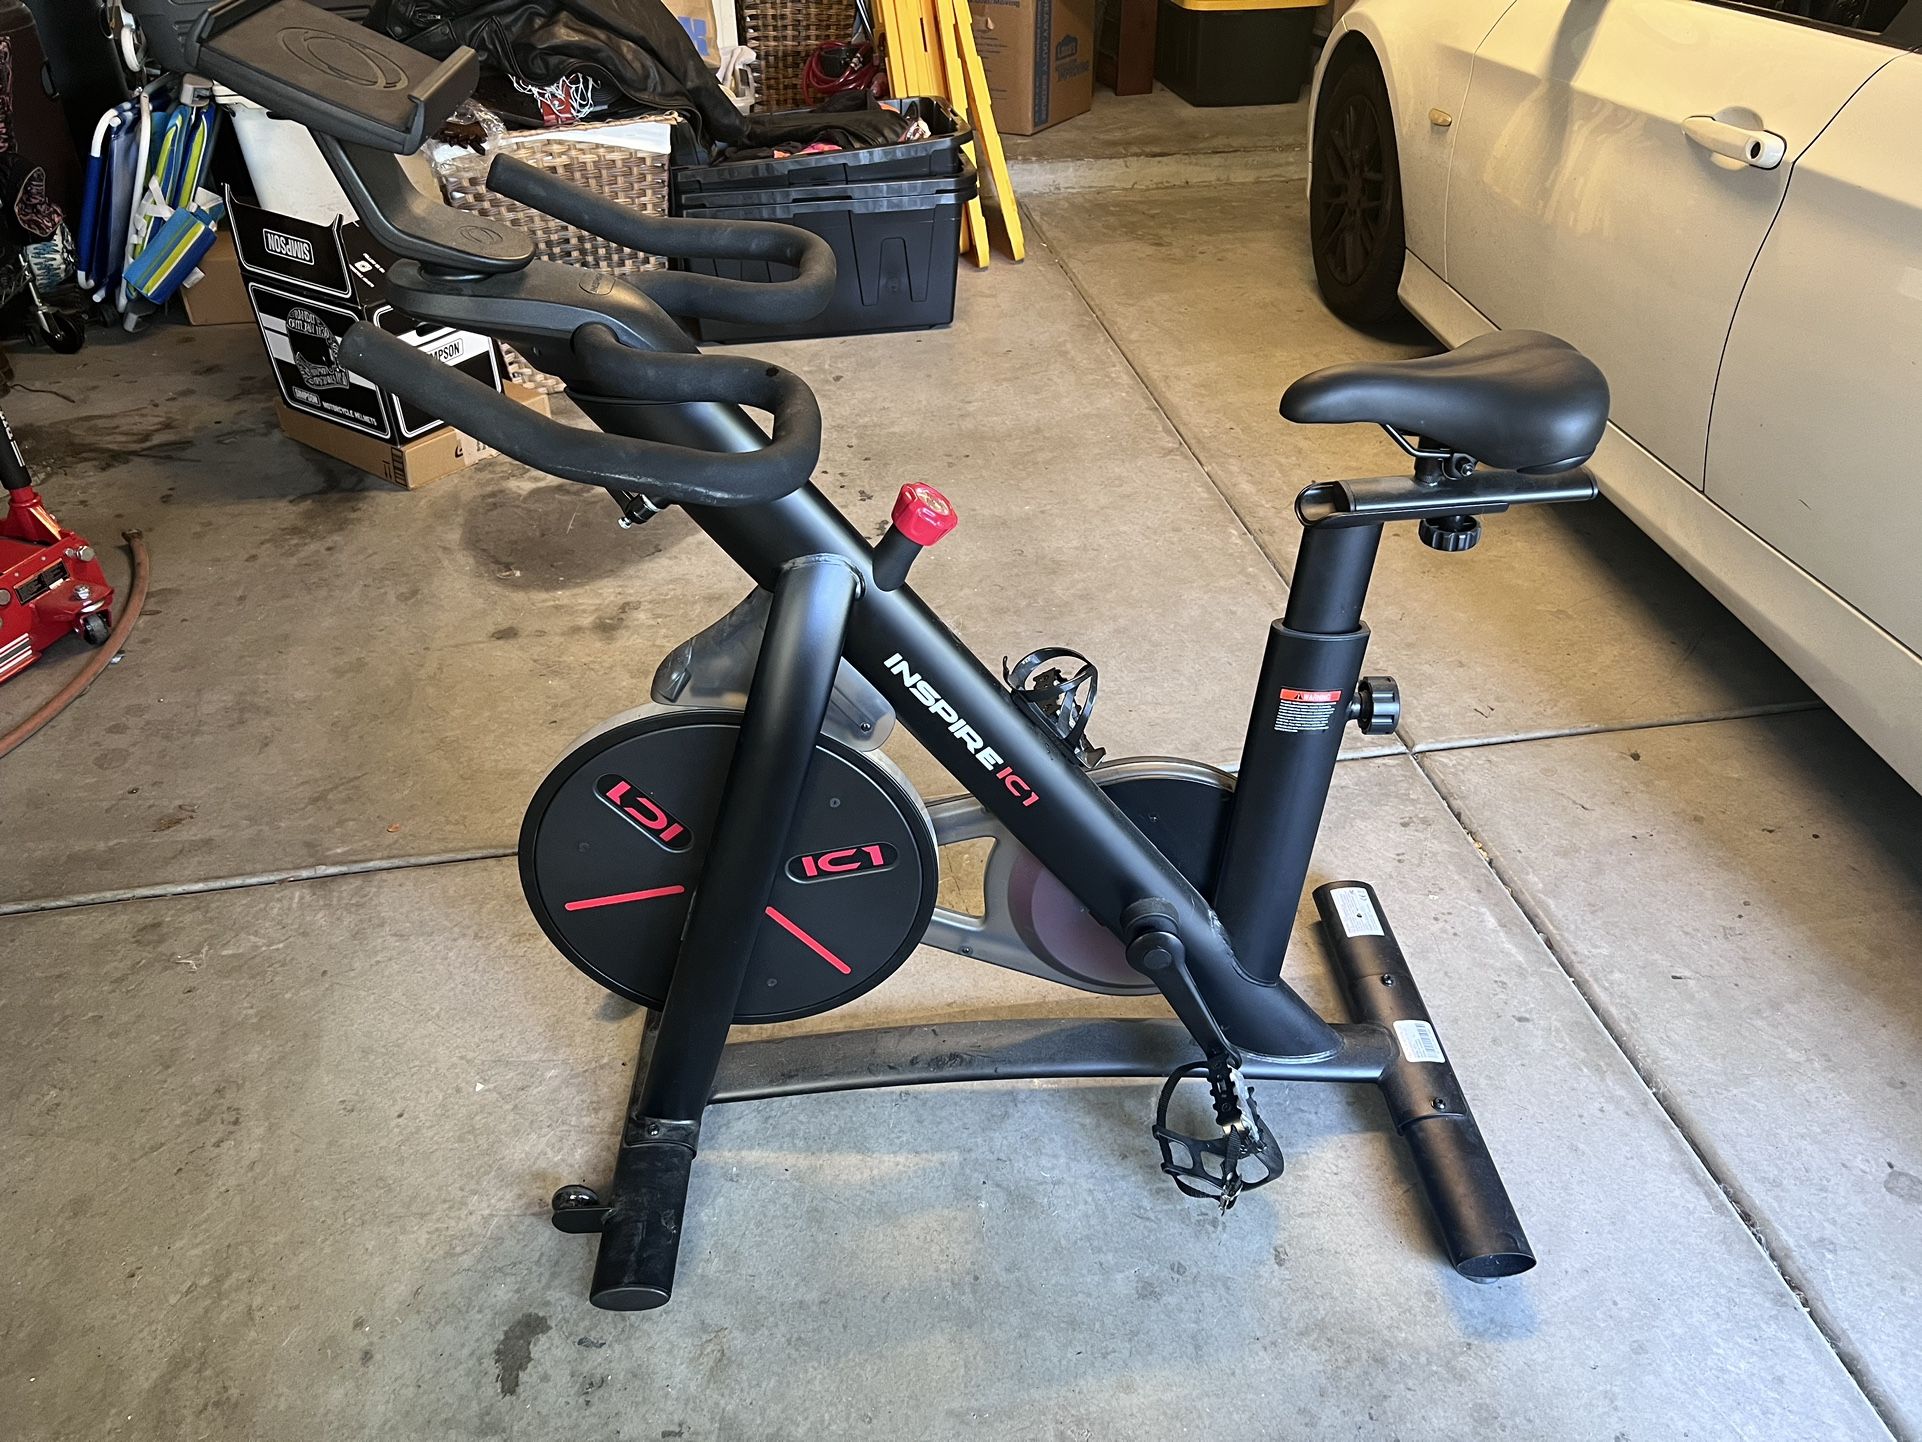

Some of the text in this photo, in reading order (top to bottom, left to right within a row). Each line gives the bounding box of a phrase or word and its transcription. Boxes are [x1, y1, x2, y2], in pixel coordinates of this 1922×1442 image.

[266, 232, 310, 261] SIMPSON
[430, 341, 460, 361] MPSON
[883, 652, 1040, 807] INSPIRE IC1
[801, 845, 884, 877] IC1
